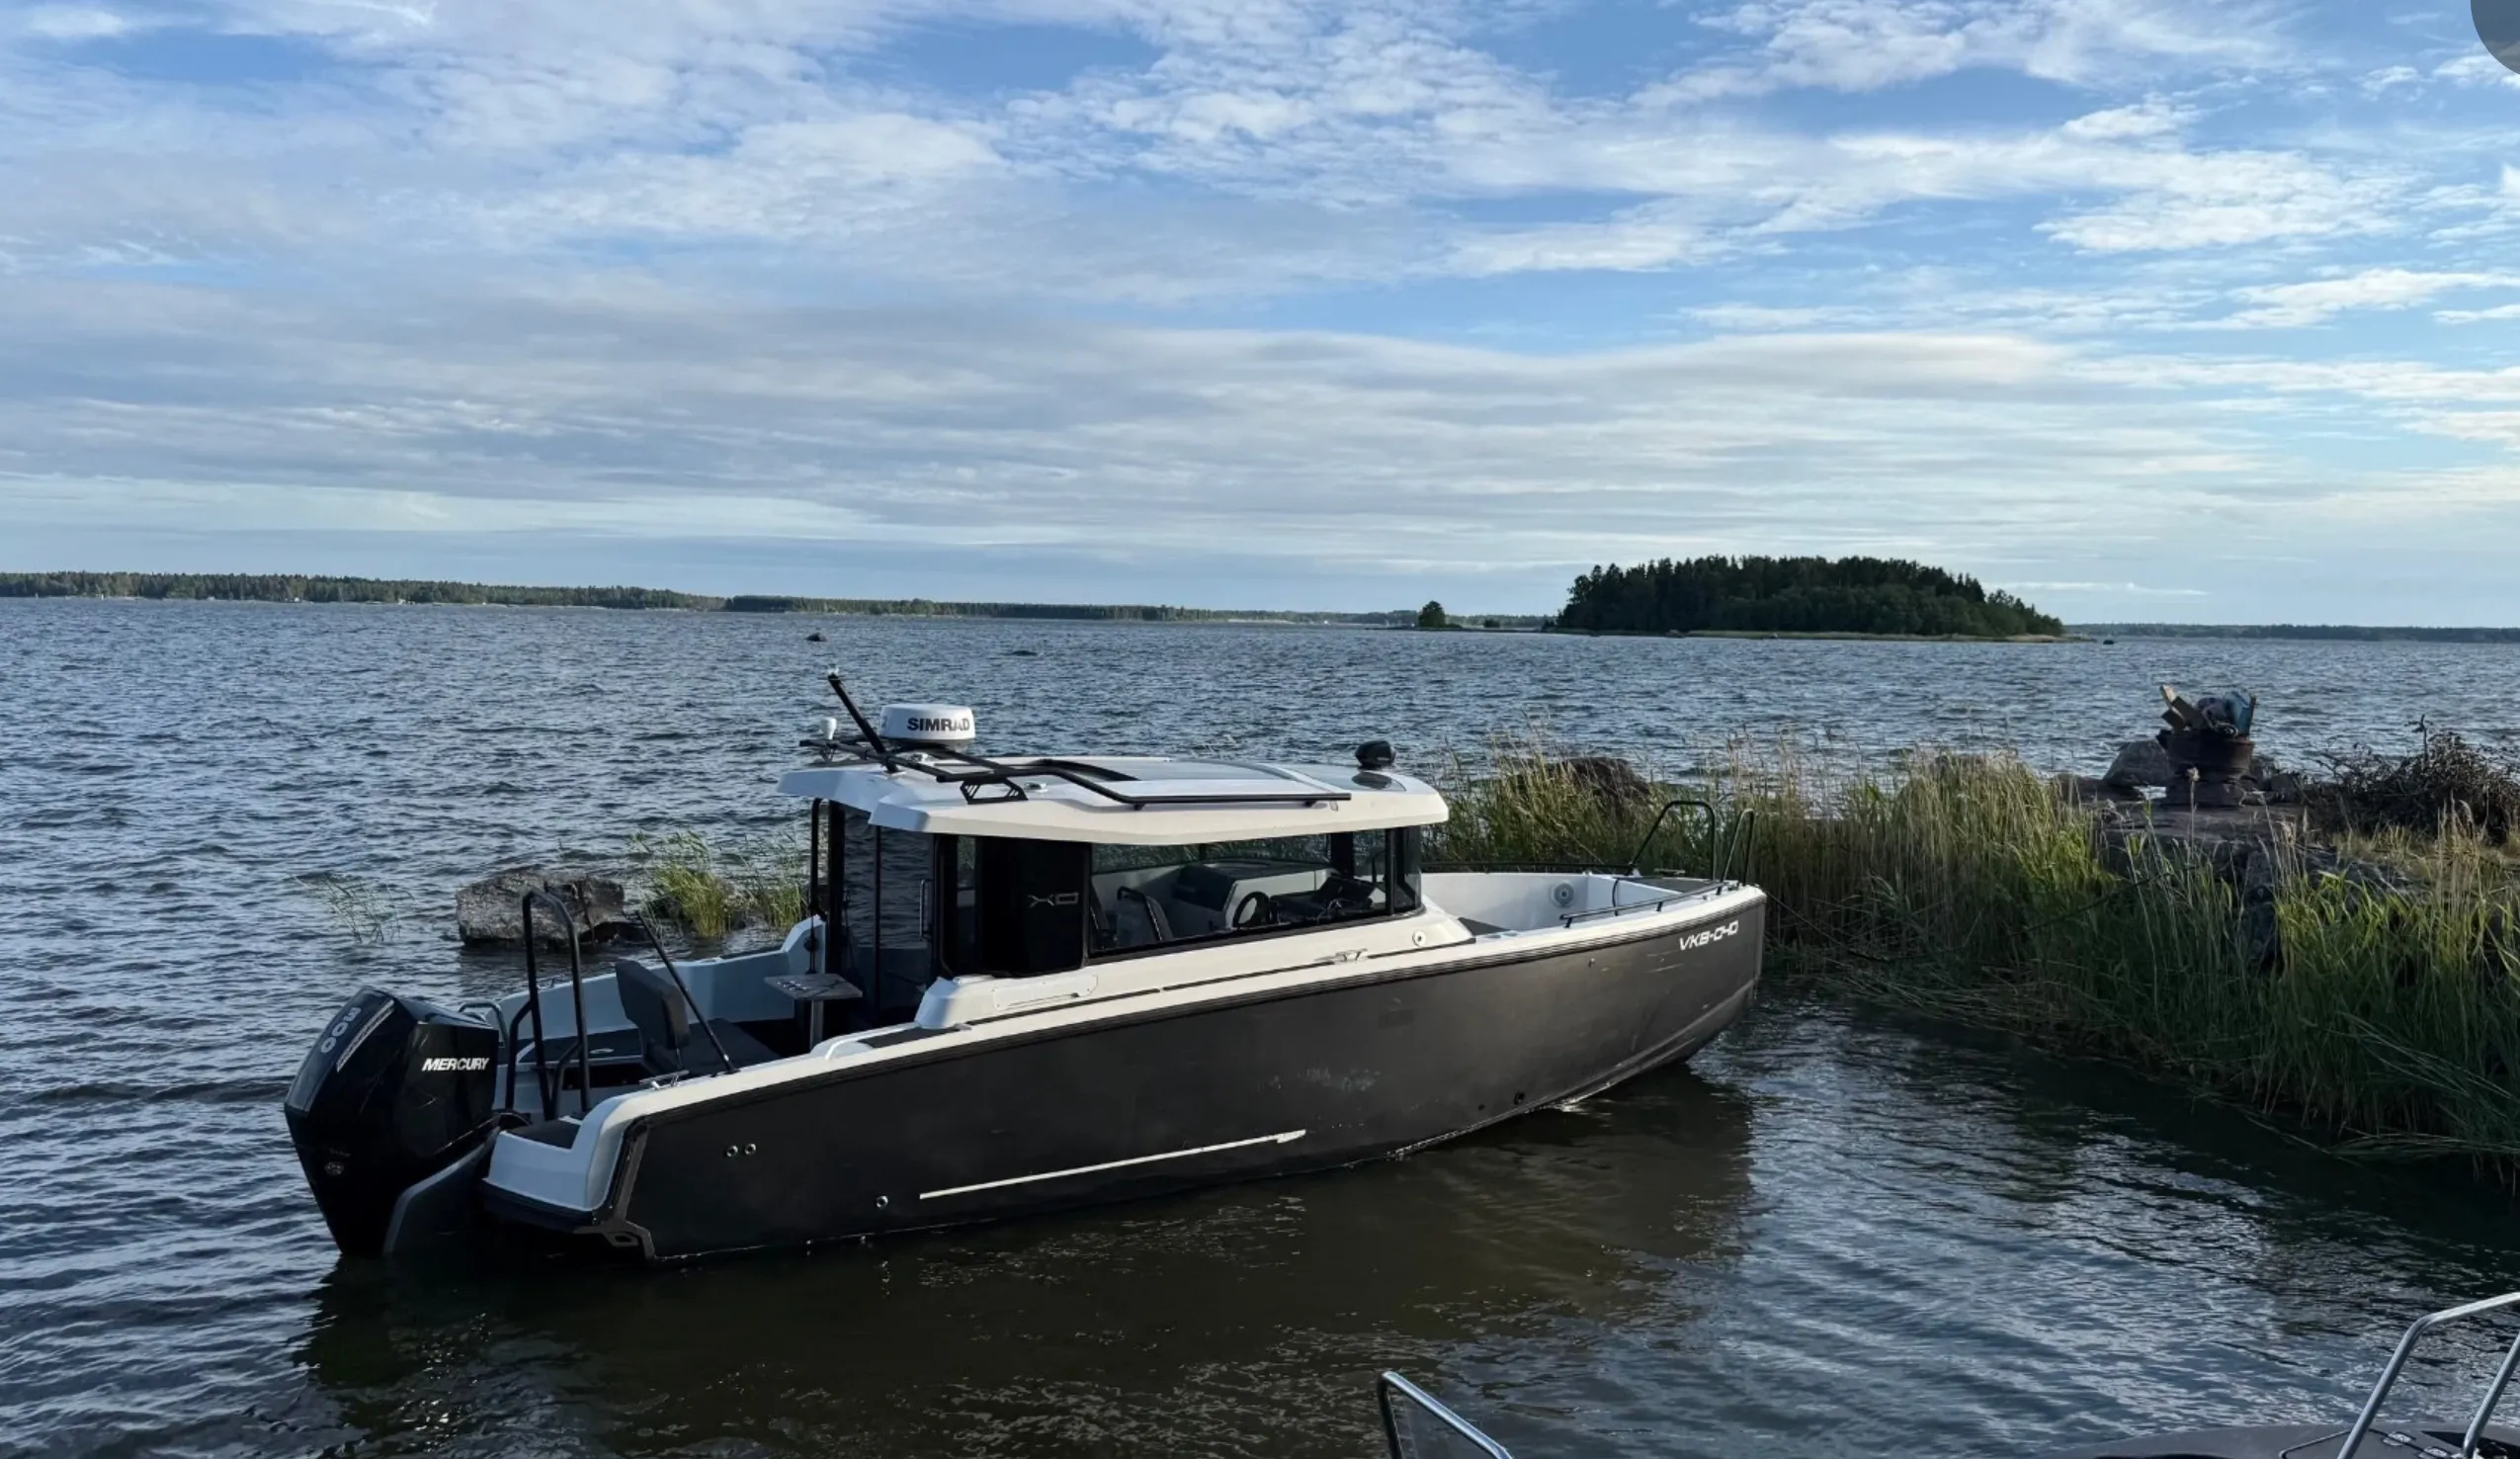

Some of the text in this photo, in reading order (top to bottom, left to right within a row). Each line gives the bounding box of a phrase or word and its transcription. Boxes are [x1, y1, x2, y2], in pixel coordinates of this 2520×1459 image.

[907, 717, 970, 731] SIMRAD
[320, 1006, 362, 1054] 300
[421, 1057, 490, 1073] MERCURY
